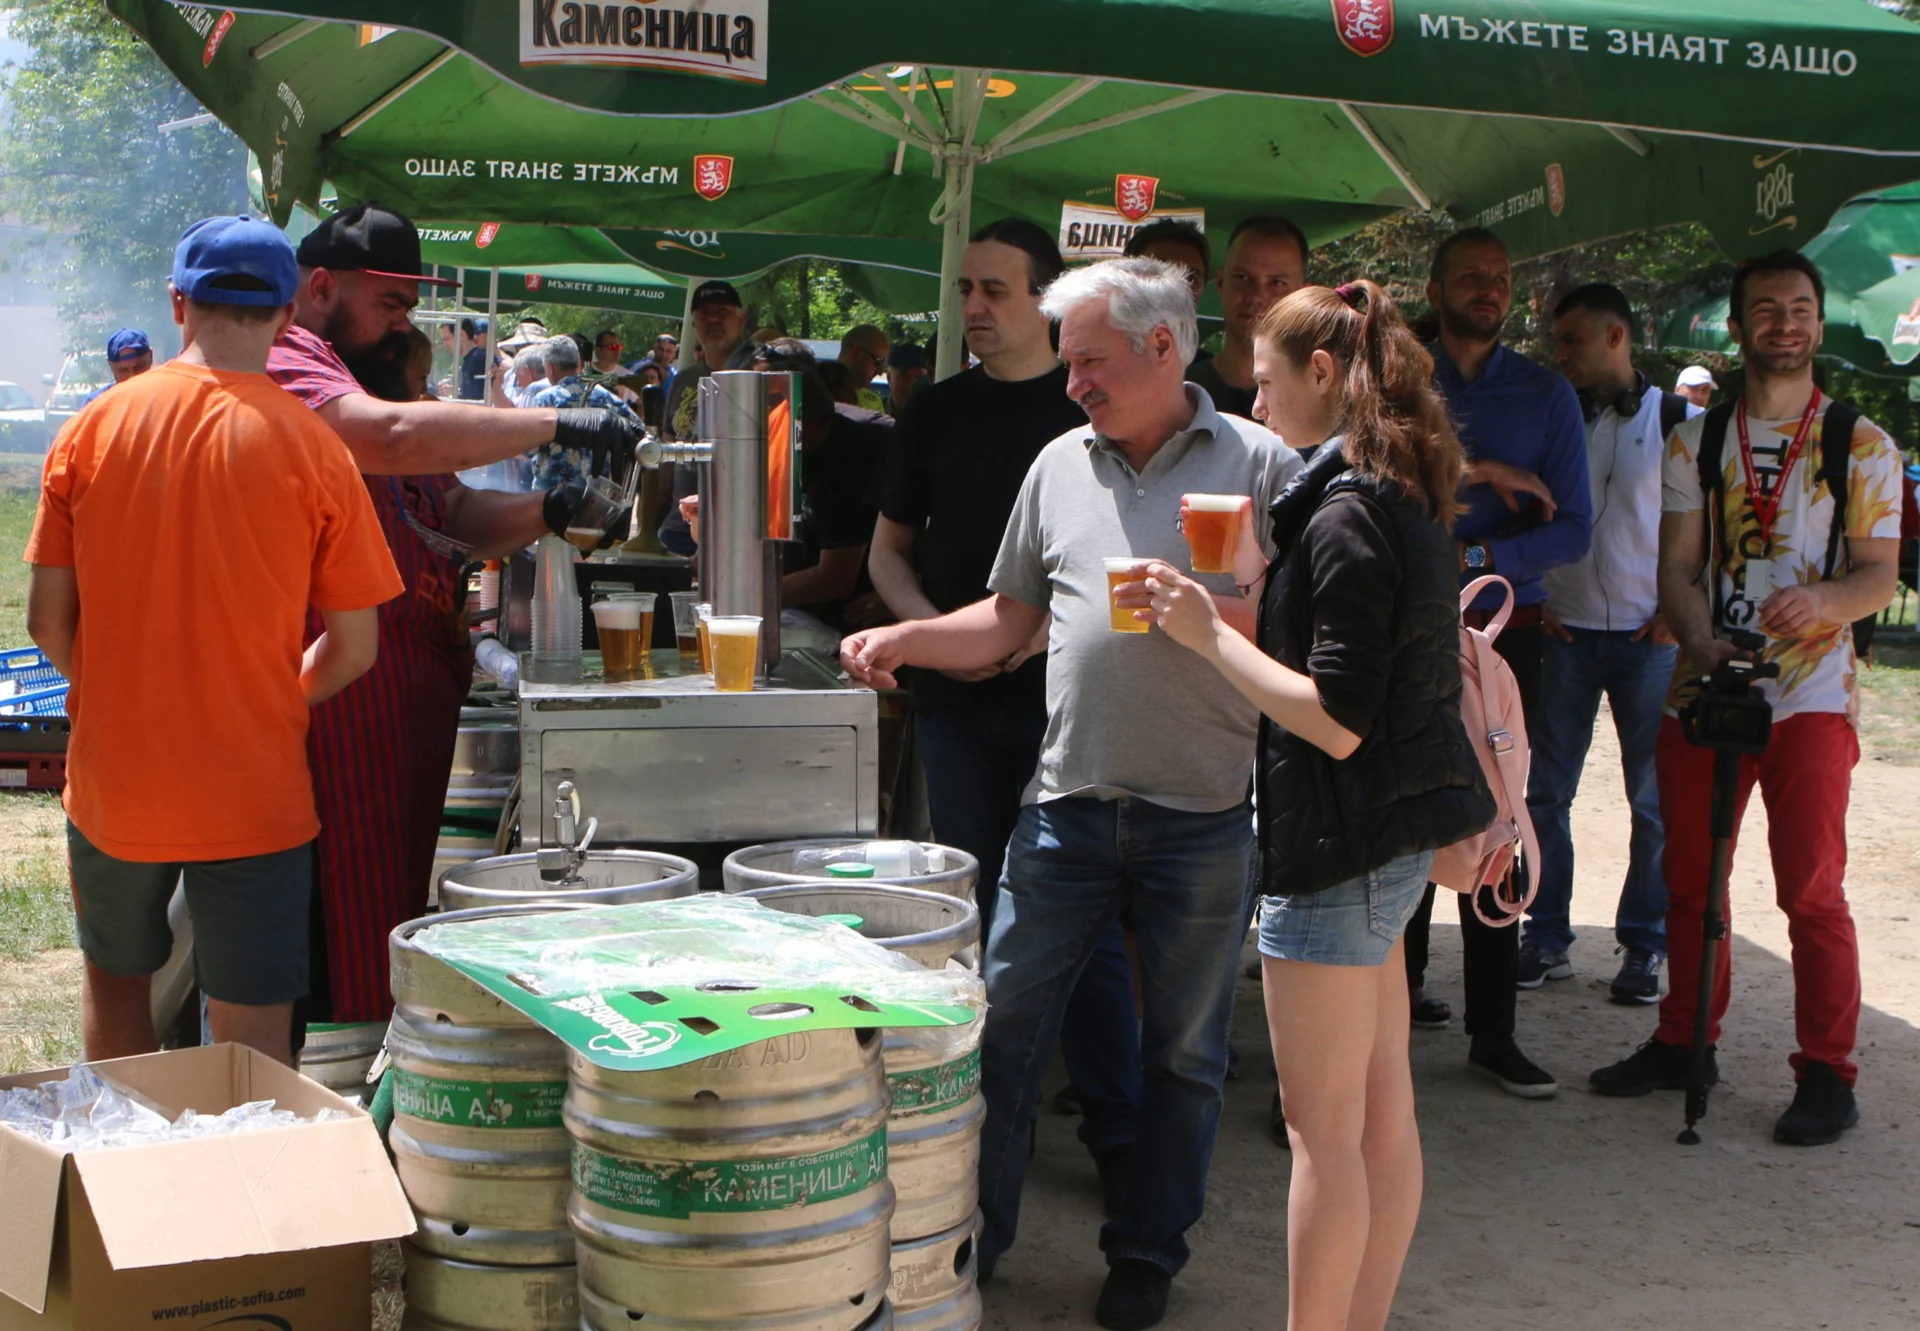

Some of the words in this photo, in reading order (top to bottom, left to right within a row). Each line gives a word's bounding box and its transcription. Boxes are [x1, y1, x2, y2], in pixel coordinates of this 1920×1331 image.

[532, 0, 756, 63] Каменица
[1419, 13, 1590, 52] МЪЖЕТЕ
[1607, 28, 1730, 65] ЗНАЯТ
[1745, 42, 1858, 77] ЗАЩО
[547, 280, 594, 293] МЪЖЕТЕ
[597, 284, 631, 296] ЗНАЯТ
[634, 289, 665, 300] ЗАЩО
[704, 1160, 857, 1203] КАМЕНИЦА
[789, 1160, 796, 1168] Е
[151, 1286, 306, 1321] www.plastic-sofia.com
